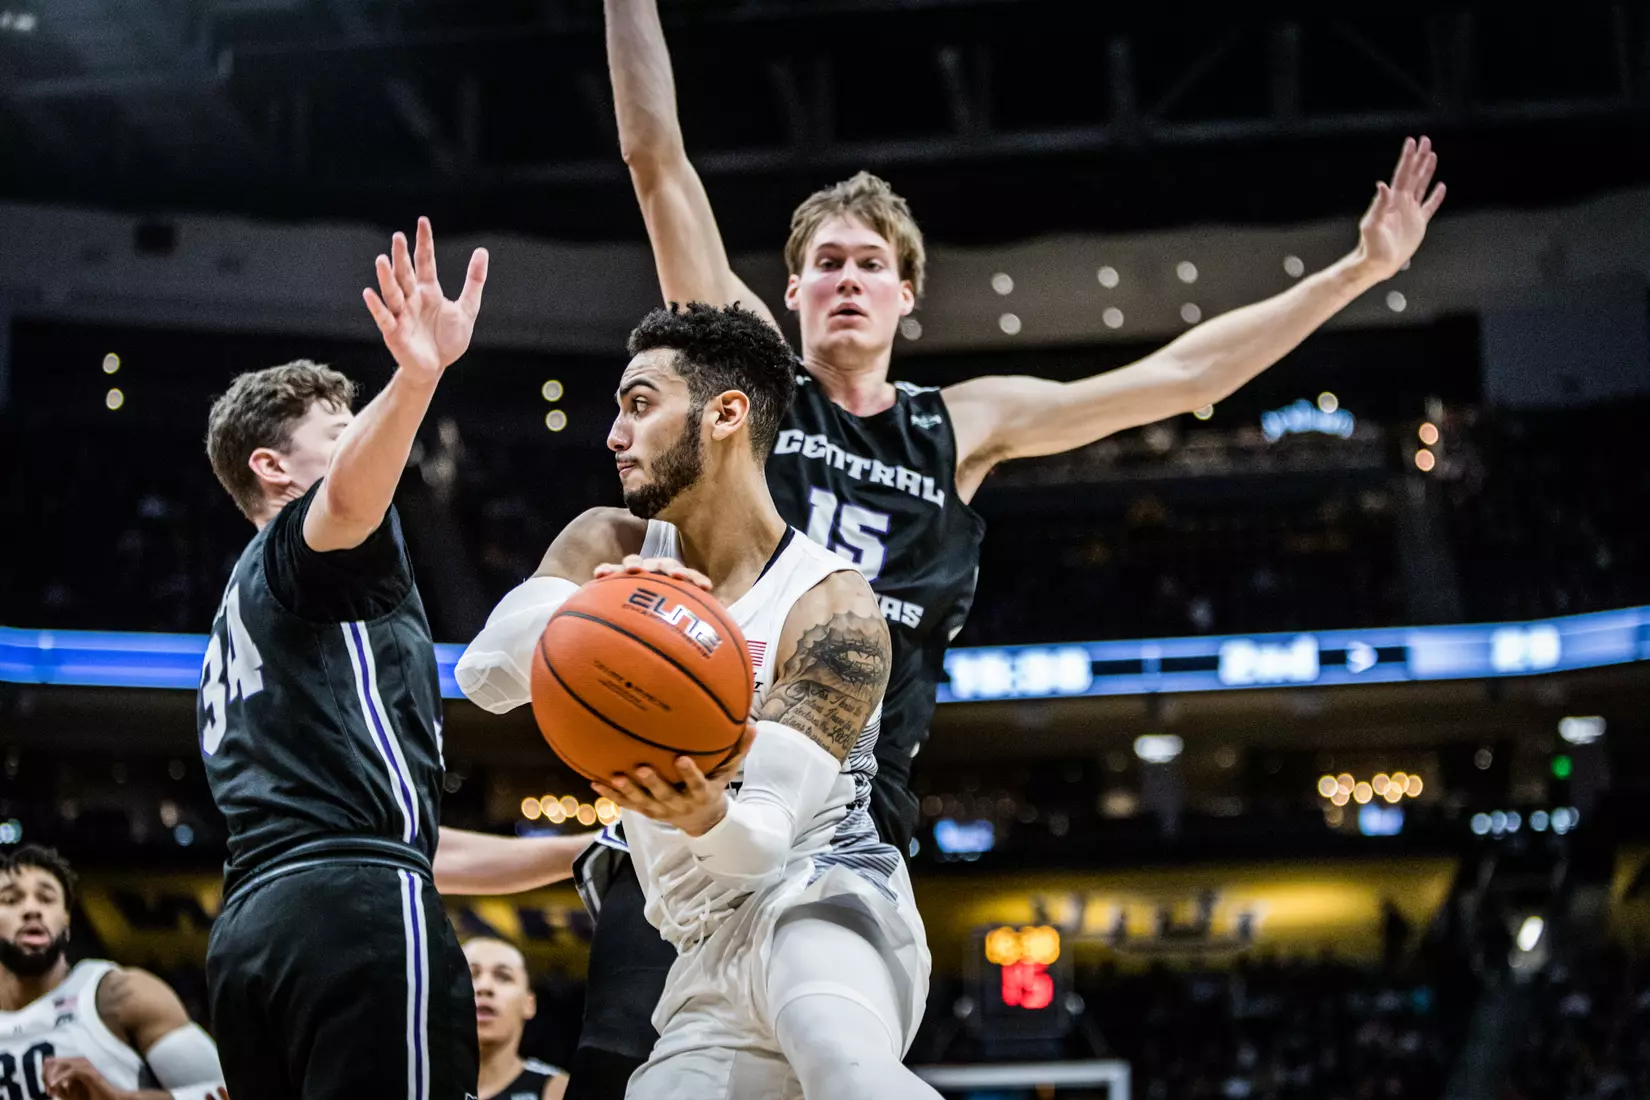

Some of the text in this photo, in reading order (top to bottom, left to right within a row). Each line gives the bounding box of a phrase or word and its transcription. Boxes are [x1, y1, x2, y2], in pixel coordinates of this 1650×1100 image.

[773, 429, 945, 508] CENTRAL
[806, 485, 891, 583] 15
[628, 587, 723, 654] ELITE
[875, 593, 925, 629] AS
